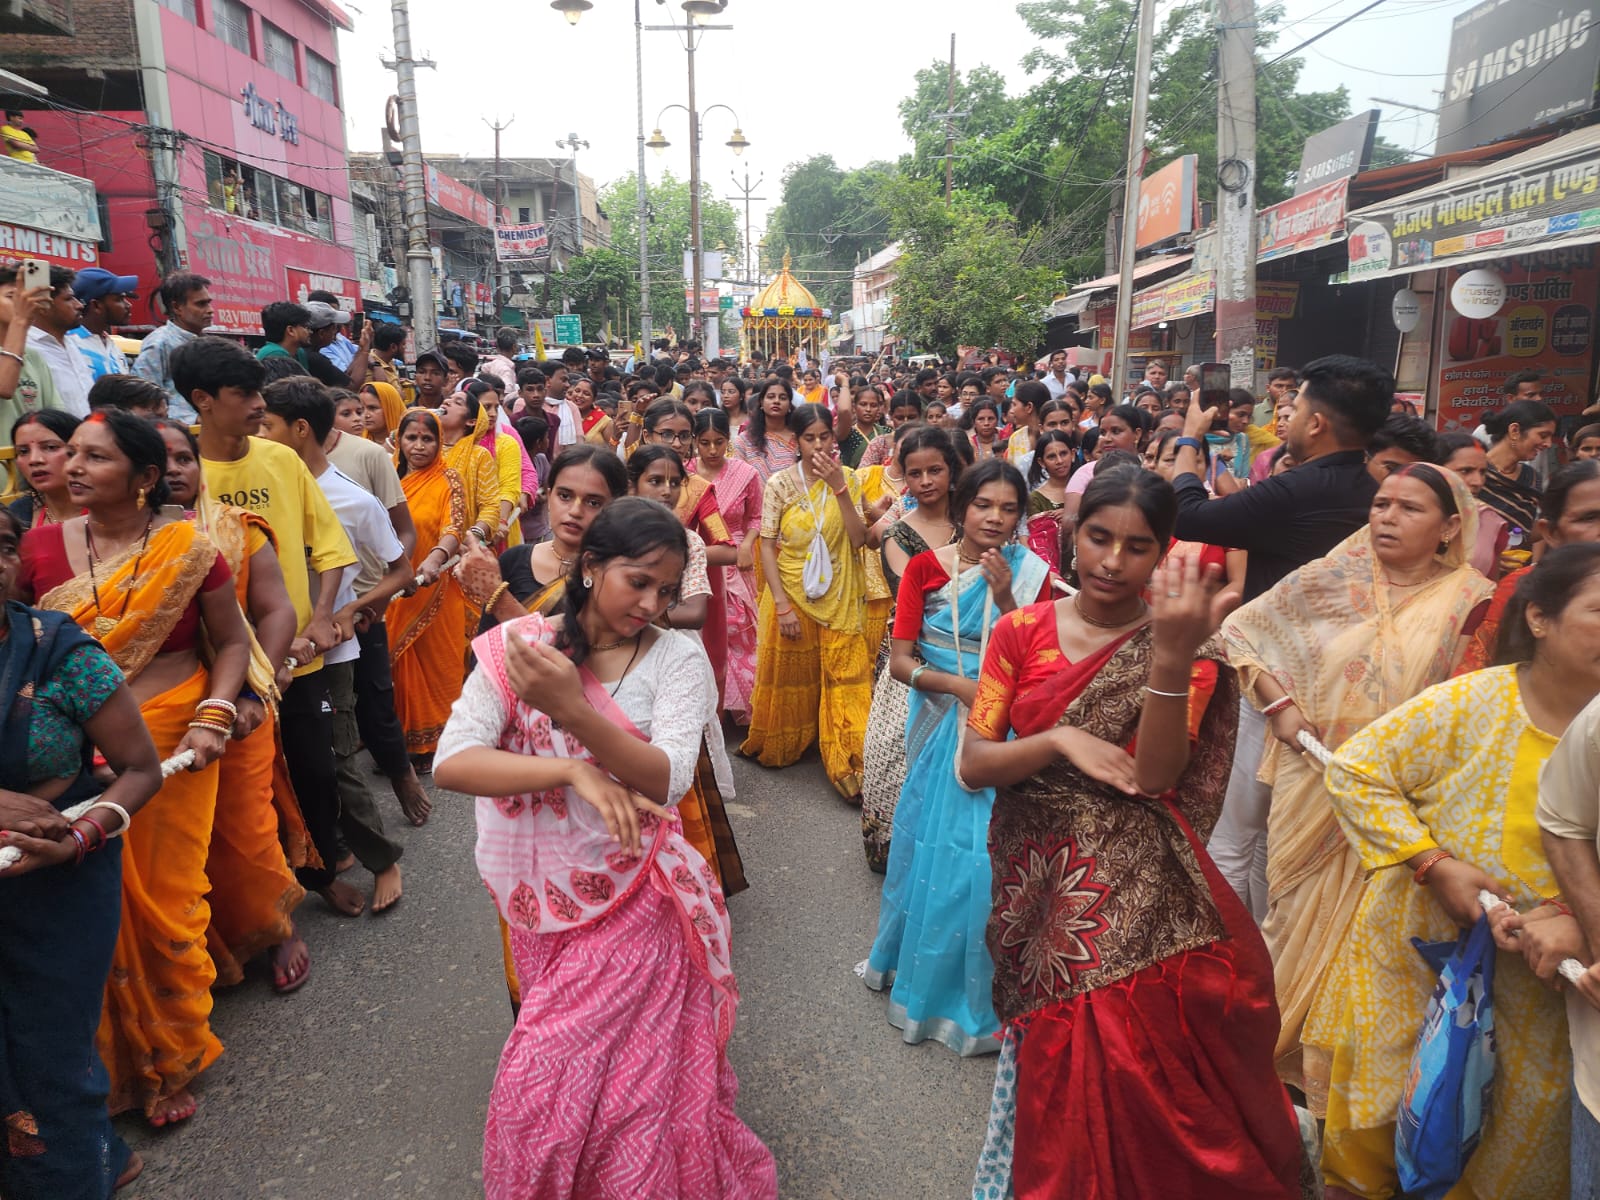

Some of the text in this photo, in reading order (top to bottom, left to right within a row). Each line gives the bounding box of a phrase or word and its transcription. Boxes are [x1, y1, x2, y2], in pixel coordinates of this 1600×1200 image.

[1450, 9, 1592, 101] SAMSUNG
[1303, 150, 1355, 184] SAMSUNG
[1392, 201, 1435, 239] अजय
[1508, 172, 1550, 210] सेल
[0, 224, 96, 262] RMENTS
[218, 308, 262, 328] Raymon
[218, 488, 269, 506] BOSS
